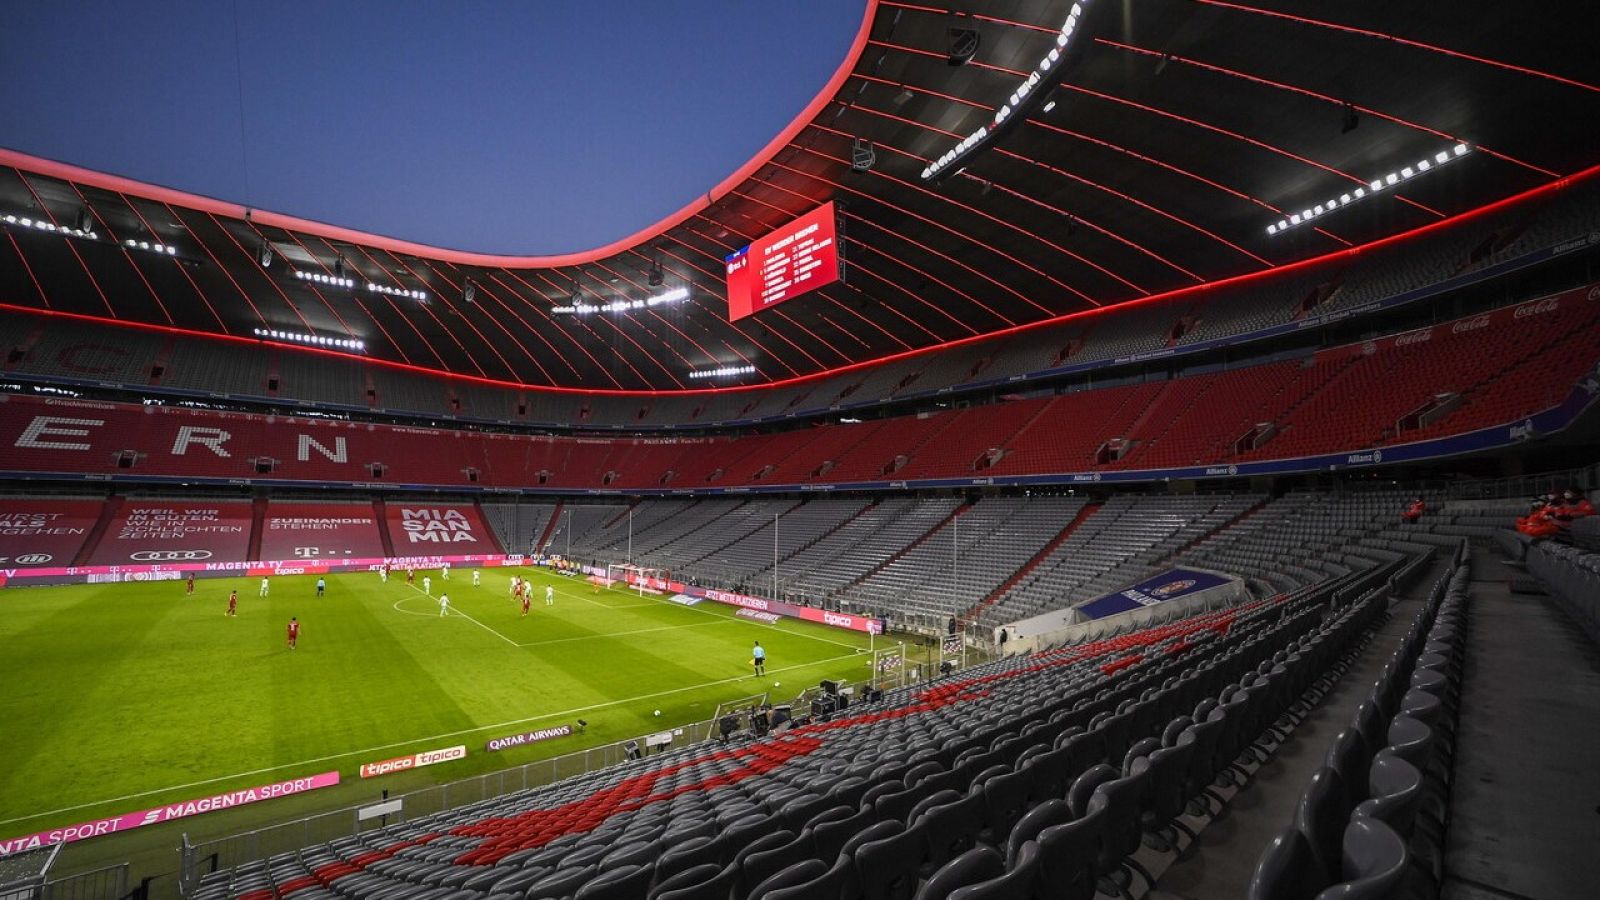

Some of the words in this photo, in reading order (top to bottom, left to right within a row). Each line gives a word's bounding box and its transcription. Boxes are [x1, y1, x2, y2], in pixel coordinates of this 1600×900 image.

[1348, 454, 1373, 463] Allianz
[401, 509, 467, 520] MIA
[402, 520, 472, 531] SAN
[408, 531, 478, 542] MIA
[206, 561, 266, 571] MAGENTA
[268, 560, 284, 569] TV
[274, 567, 305, 575] tipico
[824, 611, 852, 626] tipico
[489, 734, 526, 750] QATAR
[528, 726, 571, 742] AIRWAYS
[367, 757, 412, 775] tipico
[420, 749, 461, 764] tipico
[165, 789, 257, 820] MAGENTA
[260, 777, 313, 799] SPORT
[48, 818, 122, 845] SPORT
